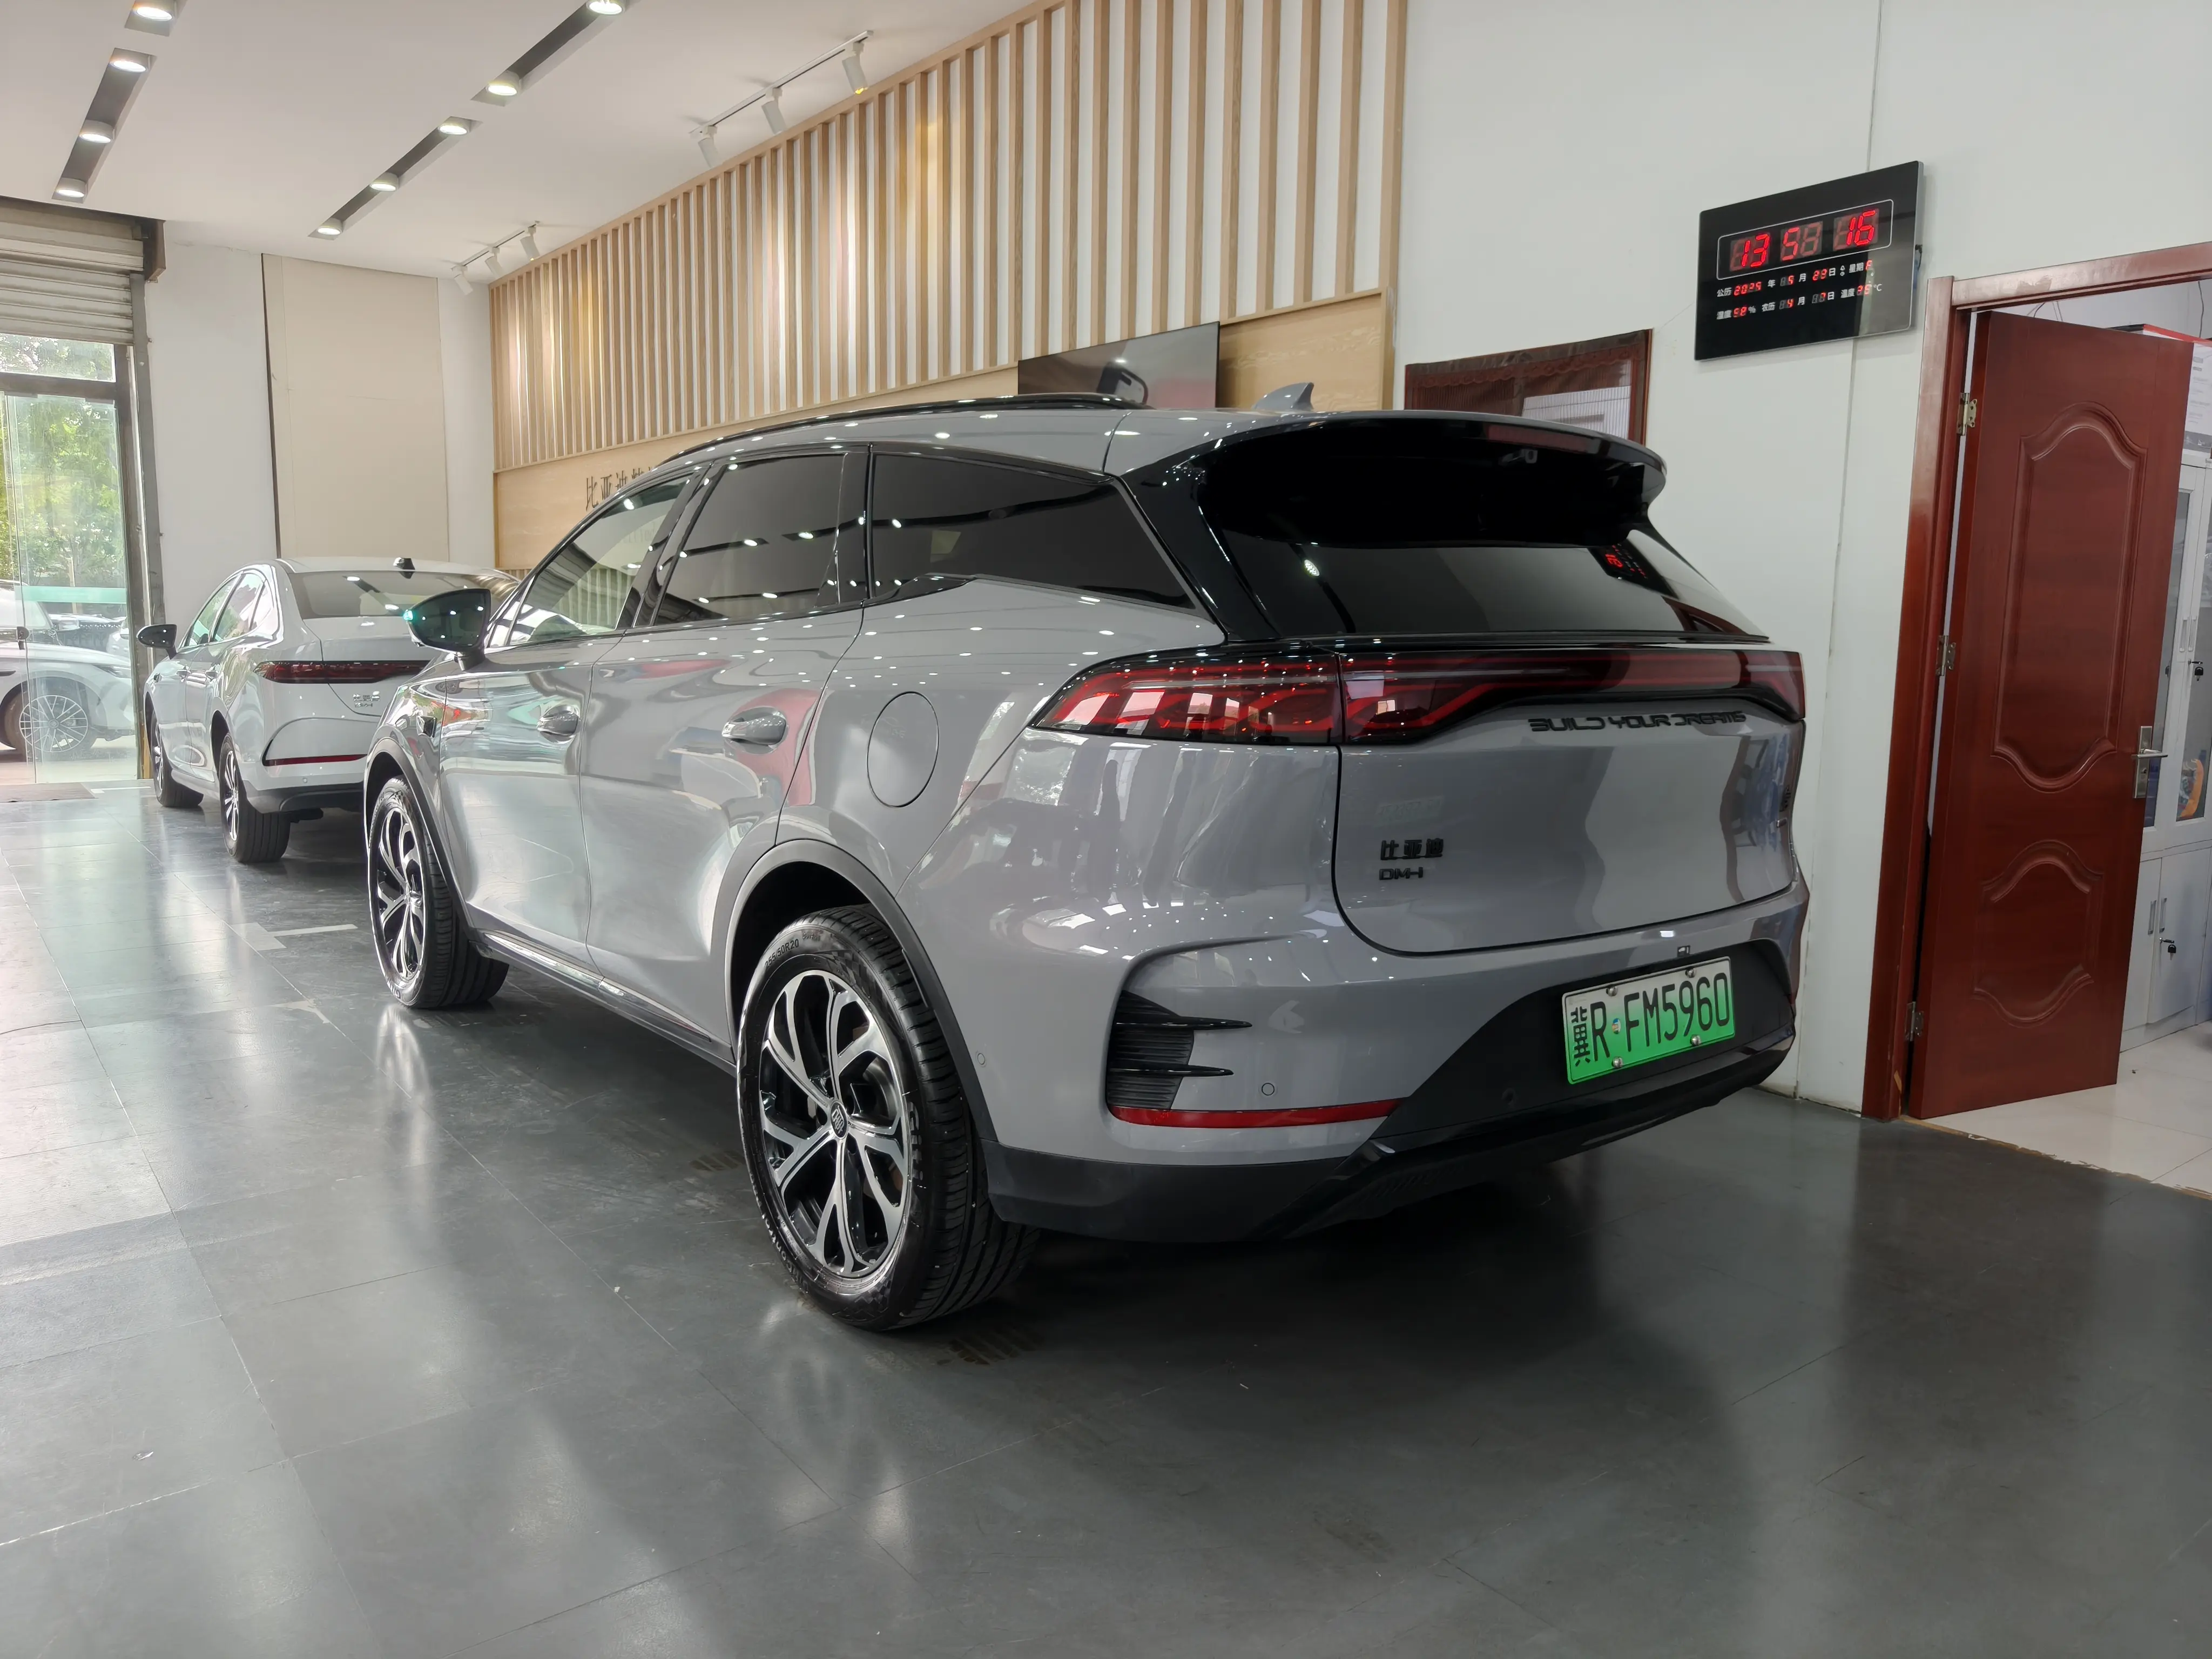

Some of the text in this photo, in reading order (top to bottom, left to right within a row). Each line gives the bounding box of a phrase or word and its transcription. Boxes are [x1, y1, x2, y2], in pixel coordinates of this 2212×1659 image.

[1740, 233, 1771, 268] 13
[1845, 209, 1877, 247] 16
[1768, 279, 1776, 288] 年
[1799, 273, 1806, 282] 月
[1829, 267, 1836, 276] 日
[1797, 296, 1805, 306] 月
[1827, 291, 1835, 300] 日
[1528, 710, 1746, 732] BUILD YOUR DREAMS
[1380, 838, 1444, 860] 比亚迪
[764, 939, 800, 970] 255/50R20
